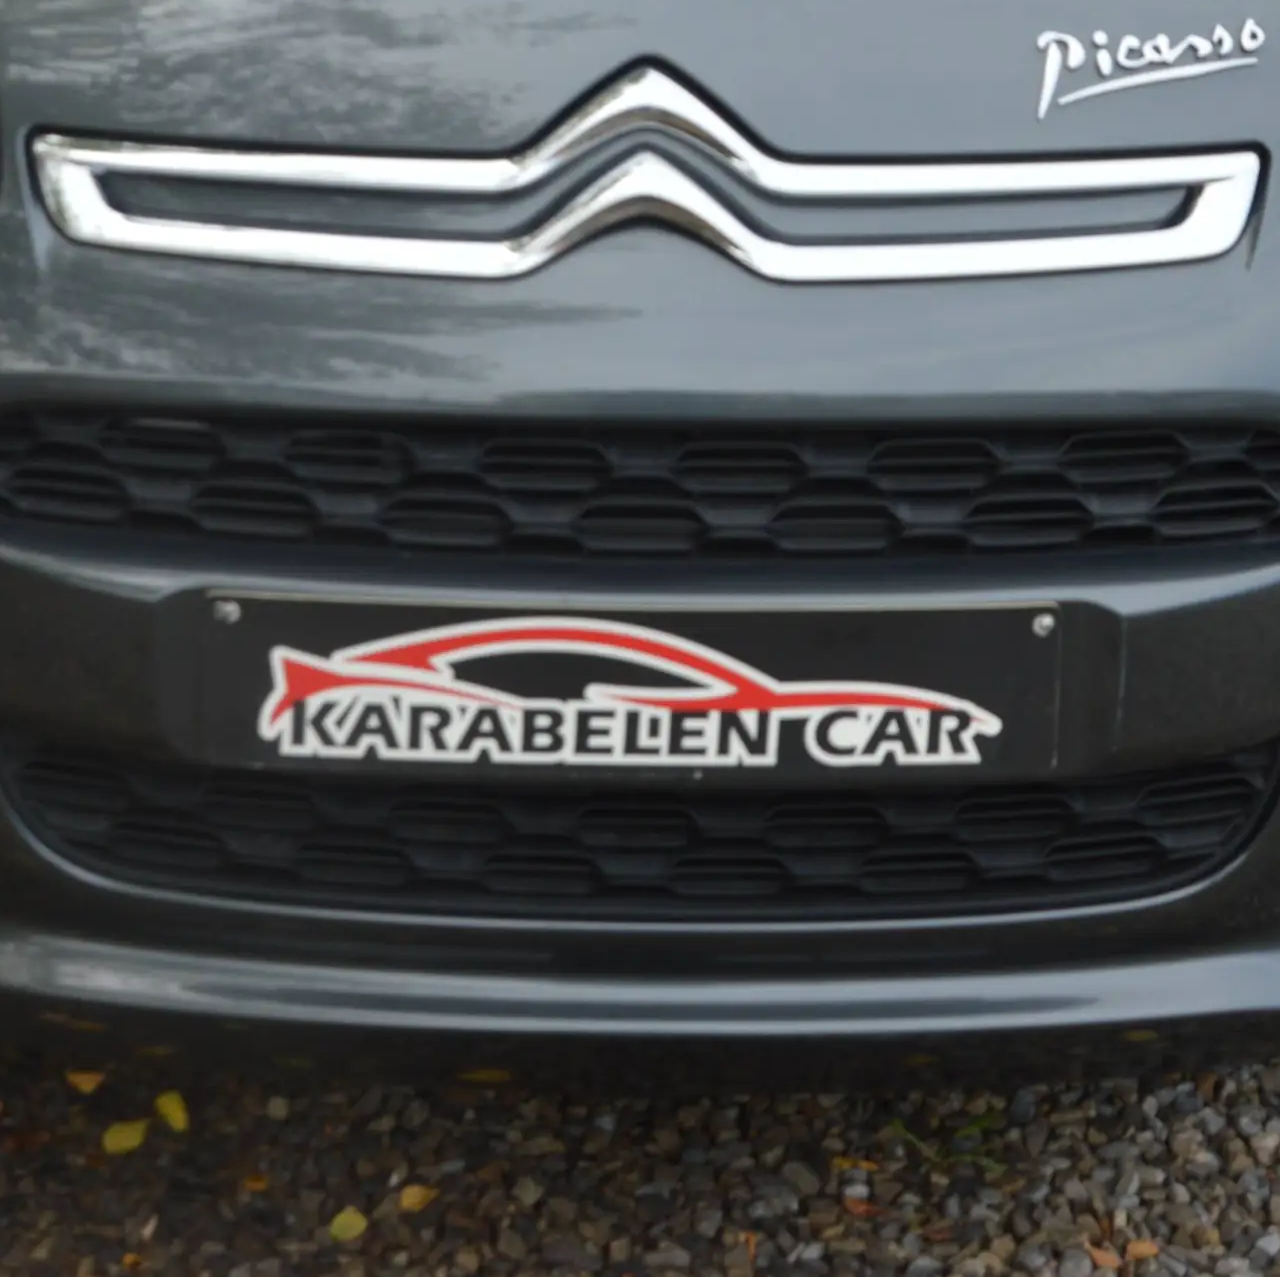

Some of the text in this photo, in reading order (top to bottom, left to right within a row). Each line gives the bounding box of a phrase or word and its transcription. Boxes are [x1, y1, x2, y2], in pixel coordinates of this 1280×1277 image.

[1036, 18, 1266, 121] Picasso
[287, 699, 978, 760] KARABELEN CAR
